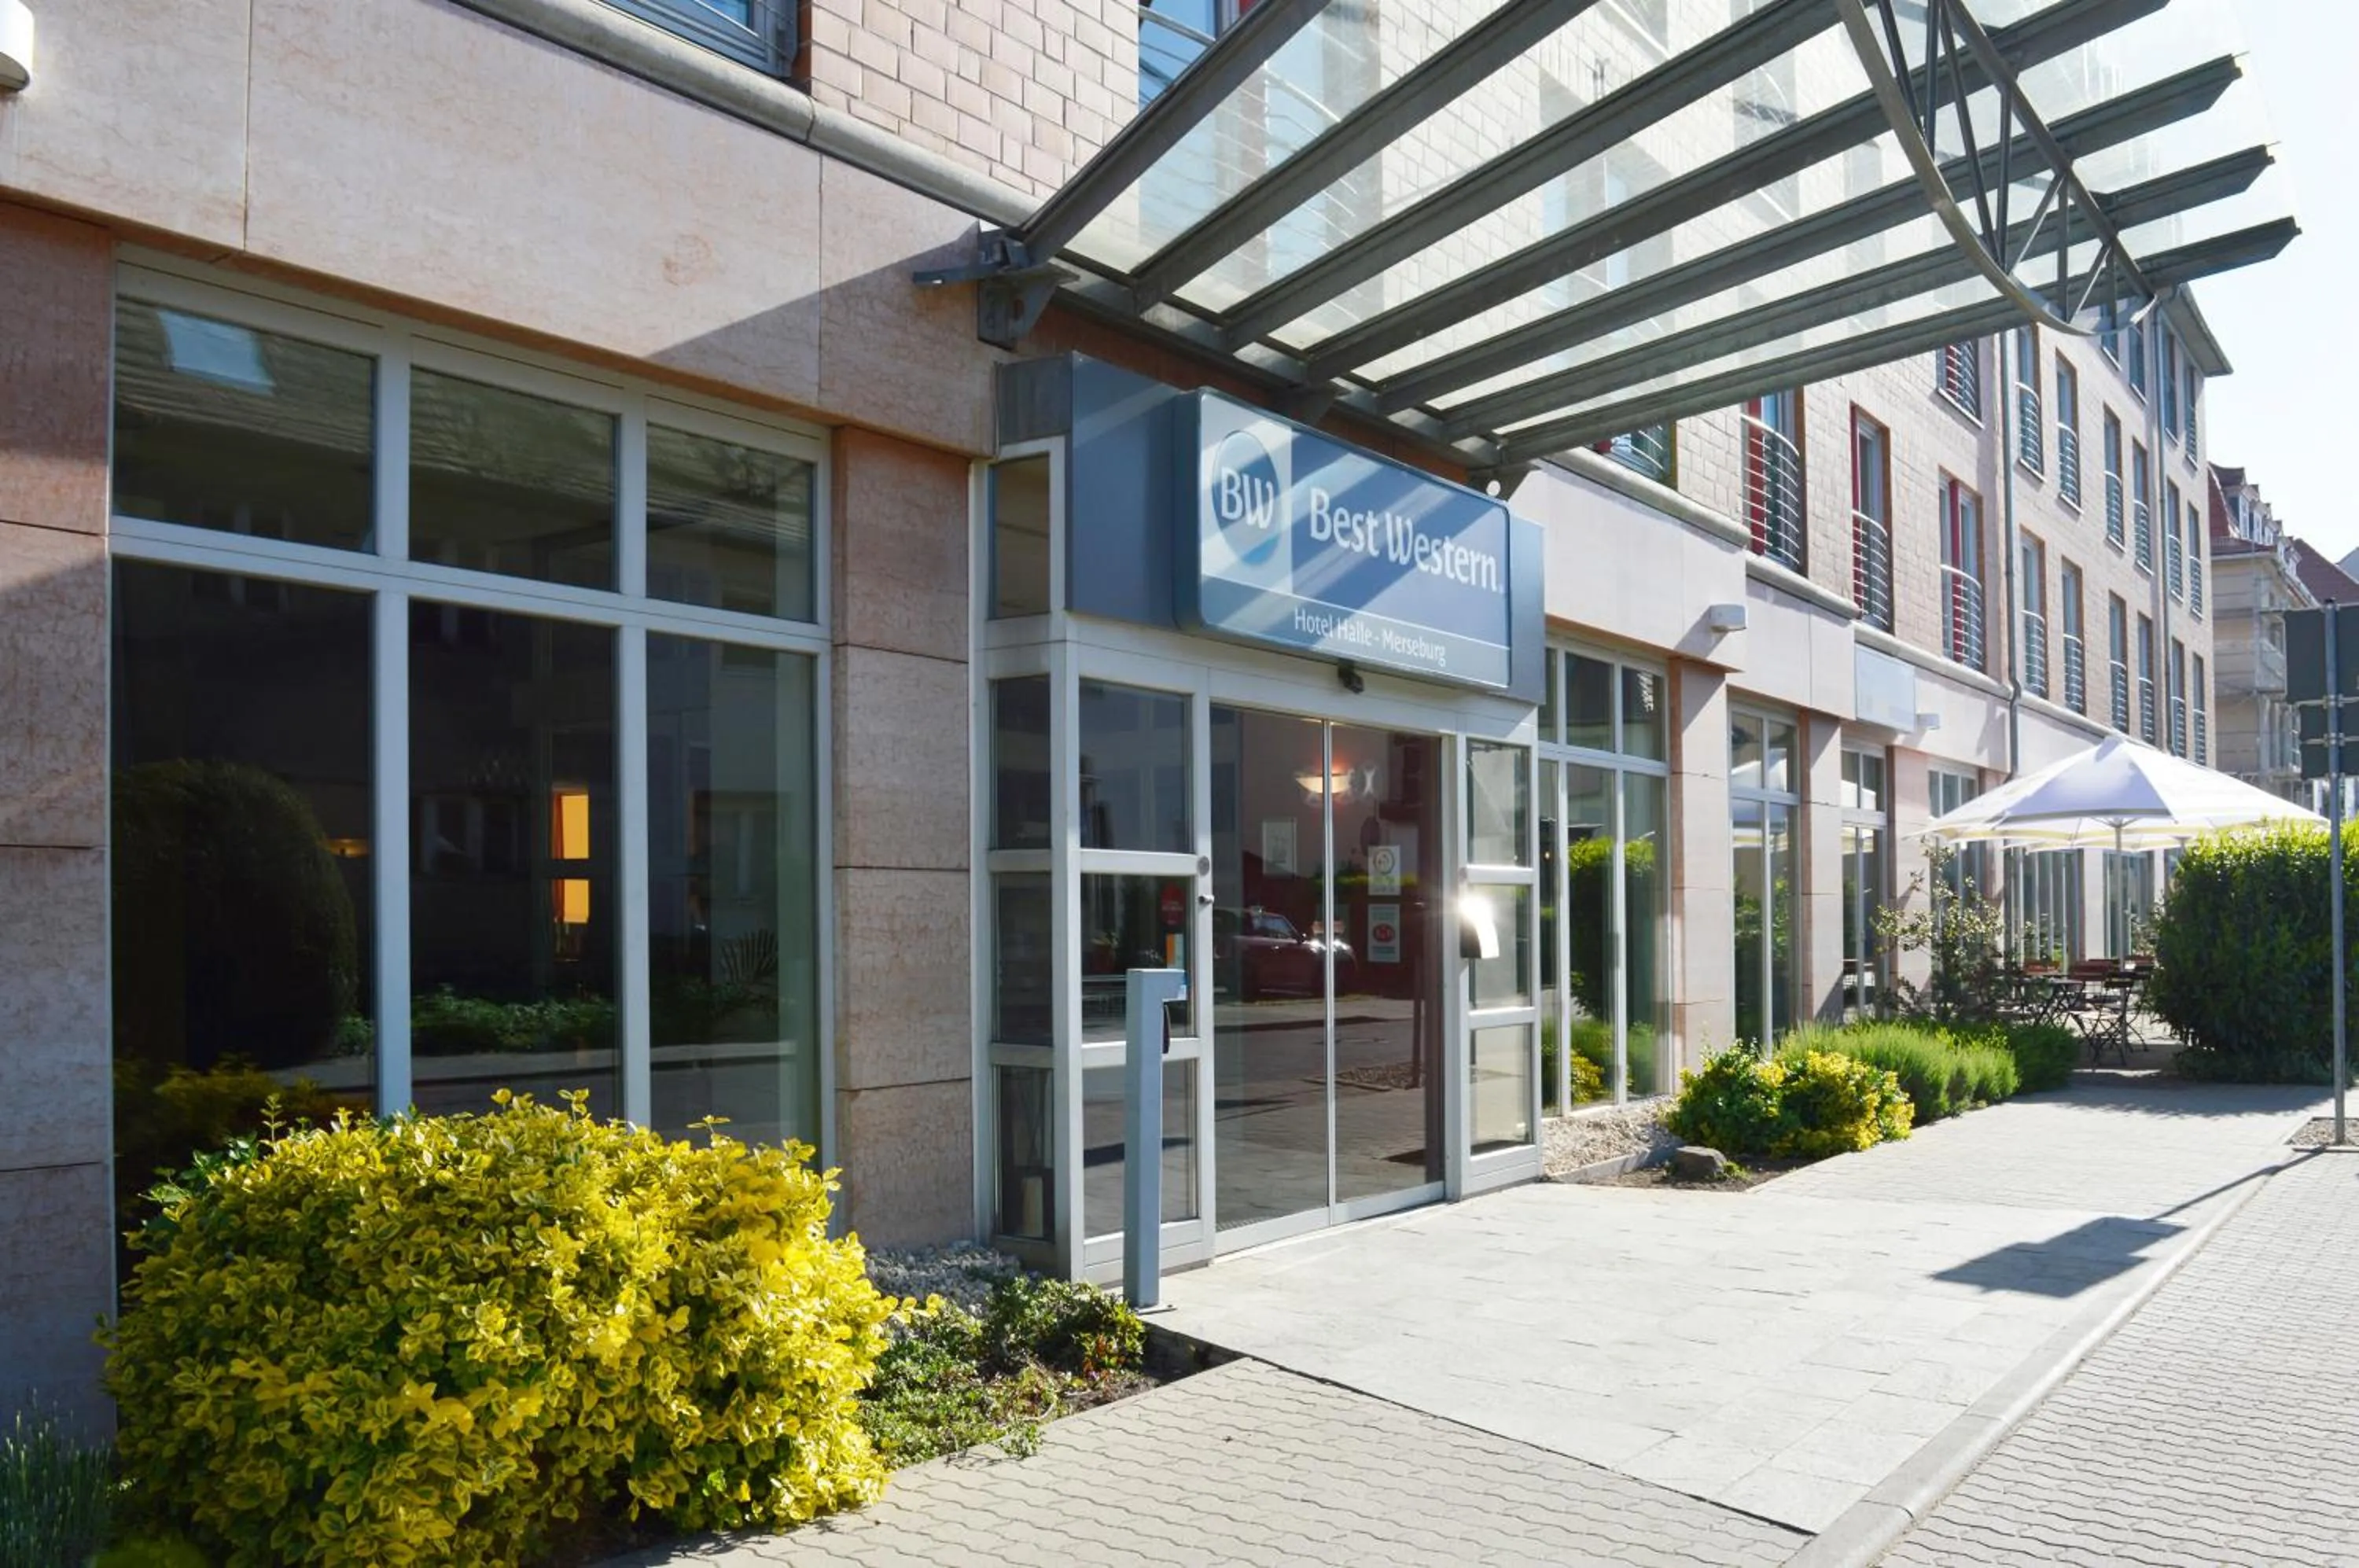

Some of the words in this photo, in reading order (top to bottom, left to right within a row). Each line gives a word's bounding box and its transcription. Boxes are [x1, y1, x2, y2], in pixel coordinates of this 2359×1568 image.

[1220, 466, 1274, 529] BW
[1310, 487, 1380, 557] Best
[1294, 608, 1333, 639] Hotel
[1338, 617, 1373, 647] Halle
[1382, 629, 1447, 668] Merseburg
